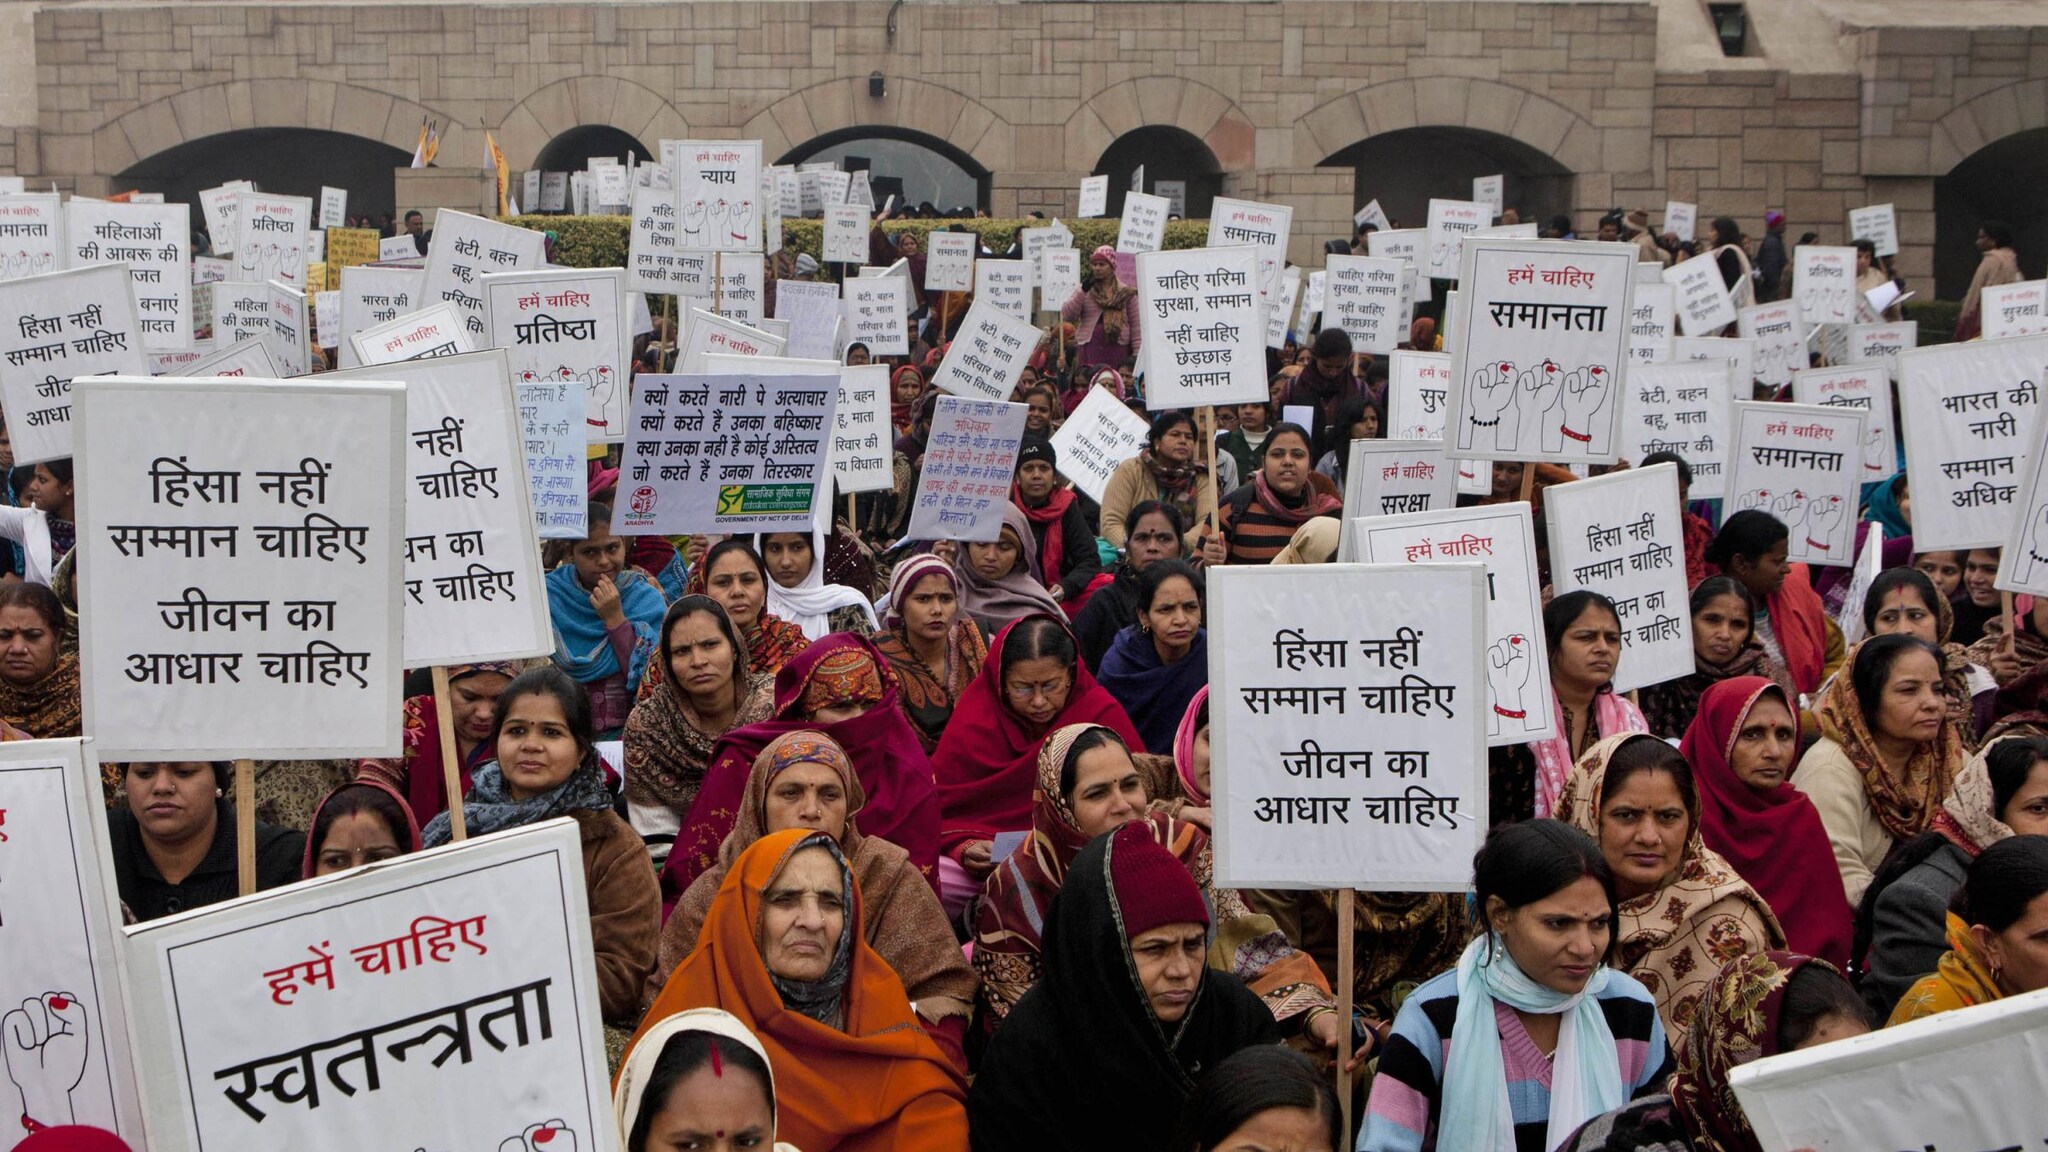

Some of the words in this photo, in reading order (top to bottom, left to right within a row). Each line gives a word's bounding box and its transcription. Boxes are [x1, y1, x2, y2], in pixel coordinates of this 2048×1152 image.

[697, 152, 709, 162] हमें
[713, 152, 740, 163] चाहिए
[700, 171, 735, 184] न्याय
[94, 221, 161, 240] महिलाओं
[253, 215, 294, 233] प्रतिष्ठा
[640, 217, 653, 230] की
[1224, 227, 1276, 245] समानता
[78, 241, 99, 260] की
[106, 248, 151, 261] आबरू
[158, 244, 178, 262] की
[455, 237, 482, 260] बेटी,
[490, 249, 518, 266] बहन
[638, 255, 652, 264] हम
[657, 256, 673, 266] सब
[678, 256, 704, 270] बनाएं
[639, 267, 666, 280] पक्की
[670, 272, 700, 283] आदत
[728, 273, 746, 286] नहीं
[1157, 270, 1199, 290] चाहिए
[1204, 268, 1245, 287] गरिमा
[1337, 268, 1364, 282] चाहिए
[1368, 270, 1394, 282] गरिमा
[1508, 264, 1534, 285] हमें
[1541, 266, 1594, 289] चाहिए
[362, 296, 389, 306] भारत
[394, 293, 408, 306] की
[518, 292, 540, 310] हमें
[545, 291, 589, 307] चाहिए
[727, 287, 755, 301] चाहिए
[1366, 286, 1396, 296] सम्मान
[140, 293, 178, 314] बनाएं
[1153, 297, 1198, 318] सुरक्षा,
[1205, 294, 1251, 309] सम्मान
[1338, 301, 1355, 313] नहीं
[1358, 303, 1385, 316] चाहिए
[18, 314, 62, 338] हिंसा
[67, 304, 102, 328] नहीं
[222, 313, 236, 326] की
[1489, 302, 1607, 332] समानता
[385, 337, 403, 352] हमें
[406, 324, 439, 343] चाहिए
[514, 314, 596, 344] प्रतिष्ठा
[1165, 324, 1192, 345] नहीं
[1197, 322, 1239, 342] चाहिए
[5, 343, 66, 366] सम्मान
[72, 330, 127, 354] चाहिए
[710, 333, 724, 345] हमें
[729, 340, 757, 355] चाहिए
[1002, 334, 1021, 349] बहन
[993, 347, 1012, 363] माता
[1175, 347, 1232, 368] छेड़छाड़
[1639, 349, 1653, 358] का
[963, 354, 992, 375] परिवार
[993, 370, 1006, 382] की
[1180, 372, 1230, 387] अपमान
[645, 383, 669, 406] क्यों
[679, 383, 709, 406] करतें
[720, 384, 747, 406] नारी
[756, 384, 766, 406] पे
[775, 391, 828, 406] अत्याचार
[952, 367, 972, 383] भाग्य
[973, 376, 1002, 399] विधाता
[853, 390, 875, 403] बहन
[1420, 389, 1447, 413] सुर
[1640, 386, 1670, 404] बेटी,
[1677, 388, 1708, 402] बहन
[1942, 392, 1998, 413] भारत
[2006, 380, 2037, 406] की
[641, 409, 665, 431] क्यों
[674, 409, 704, 431] करते
[713, 409, 723, 432] हैं
[731, 416, 766, 431] उनका
[774, 409, 824, 432] बहिष्कार
[852, 411, 874, 423] माता
[1643, 414, 1668, 430] बहू,
[1675, 411, 1706, 424] माता
[1969, 412, 2016, 439] नारी
[412, 416, 464, 457] नहीं
[864, 433, 878, 448] की
[1098, 413, 1120, 435] भारत
[1121, 433, 1134, 446] की
[1767, 422, 1787, 435] हमें
[1792, 424, 1834, 441] चाहिए
[637, 441, 661, 456] क्या
[664, 441, 700, 456] उनका
[704, 434, 728, 457] नहीं
[731, 434, 741, 457] है
[744, 433, 771, 459] कोई
[772, 433, 819, 454] अस्तित्व
[1694, 435, 1713, 452] की
[633, 459, 651, 481] जो
[661, 459, 691, 481] करते
[700, 459, 710, 481] हैं
[719, 465, 754, 480] उनका
[763, 458, 815, 479] तिरस्कार
[851, 456, 882, 471] विधाता
[1069, 440, 1108, 480] अधिकारी
[1106, 458, 1120, 472] की
[1383, 462, 1398, 480] हमें
[1402, 461, 1435, 480] चाहिए
[1752, 447, 1844, 471] समानता
[1941, 457, 2014, 479] सम्मान
[148, 456, 241, 507] हिंसा
[256, 458, 332, 508] नहीं
[416, 460, 498, 499] चाहिए
[107, 526, 239, 557] सम्मान
[253, 513, 369, 564] चाहिए
[1586, 524, 1621, 552] हिंसा
[1626, 512, 1655, 541] नहीं
[446, 531, 484, 557] का
[1405, 538, 1432, 562] हमें
[1438, 534, 1492, 556] चाहिए
[1573, 558, 1623, 585] सम्मान
[1629, 543, 1672, 571] चाहिए
[433, 563, 515, 601] चाहिए
[157, 587, 270, 632] जीवन
[284, 601, 336, 631] का
[1646, 590, 1664, 610] का
[1637, 615, 1680, 643] चाहिए
[1273, 628, 1348, 671] हिंसा
[1360, 627, 1423, 670] नहीं
[125, 653, 243, 684] आधार
[257, 640, 371, 689] चाहिए
[1240, 687, 1346, 714] सम्मान
[1358, 674, 1456, 719] चाहिए
[1280, 739, 1373, 778] जीवन
[1385, 751, 1429, 778] का
[1254, 797, 1351, 824] आधार
[1363, 785, 1459, 830] चाहिए
[263, 941, 334, 1005] हमें
[350, 915, 487, 975] चाहिए
[214, 969, 552, 1123] स्वतन्त्रता
